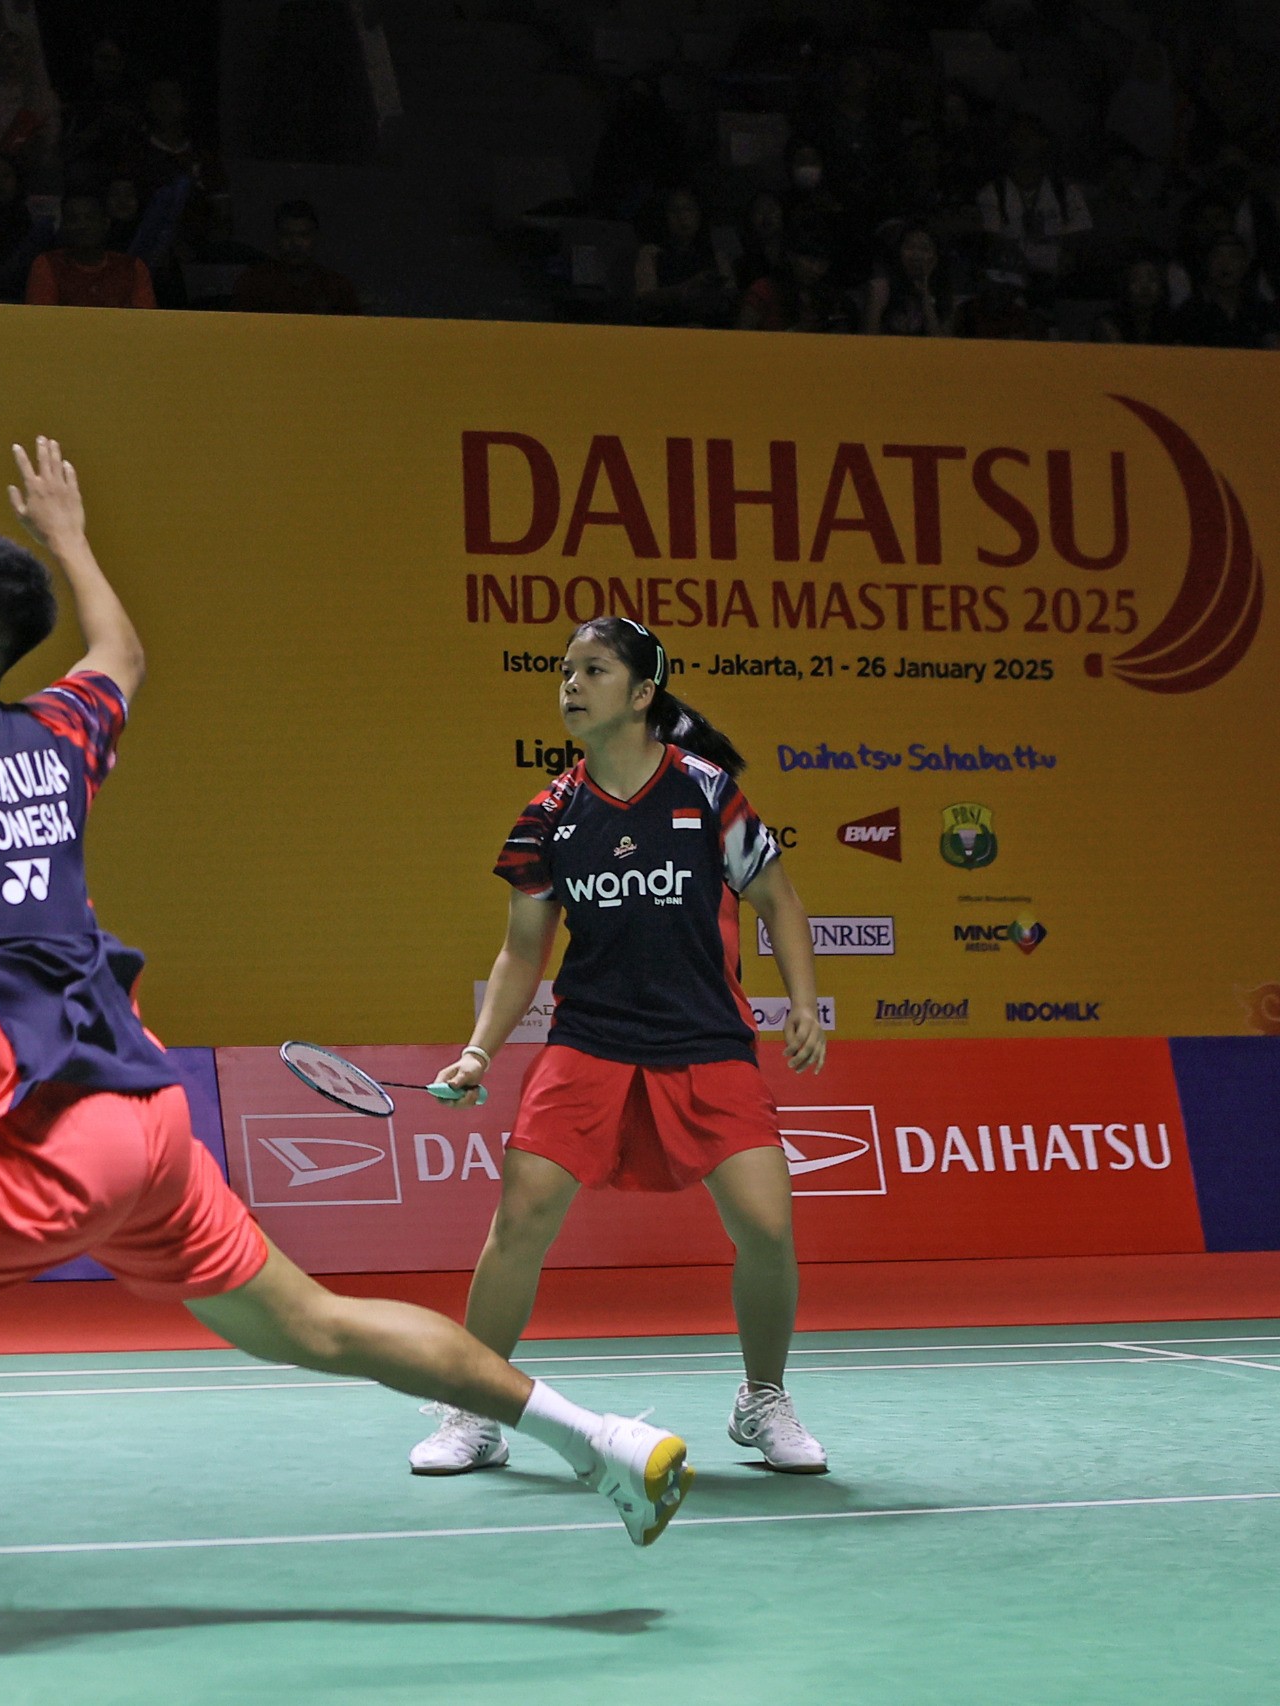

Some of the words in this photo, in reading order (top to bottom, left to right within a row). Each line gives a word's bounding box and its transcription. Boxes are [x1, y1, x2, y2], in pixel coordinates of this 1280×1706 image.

[462, 431, 1129, 571] DAIHATSU
[466, 574, 759, 628] INDONESIA
[772, 580, 1010, 632] MASTERS
[1023, 586, 1139, 634] 2025
[708, 654, 803, 680] Jakarta,
[810, 655, 833, 677] 21
[856, 656, 886, 677] 26
[894, 657, 987, 683] January
[993, 659, 1054, 681] 2025
[777, 743, 902, 772] Daihatsu
[843, 826, 897, 842] BWF
[565, 861, 692, 907] wondr
[954, 925, 1009, 941] MNC
[875, 998, 969, 1025] Indofood
[1006, 1002, 1102, 1021] INDOMILK
[894, 1123, 1172, 1173] DAIHATSU
